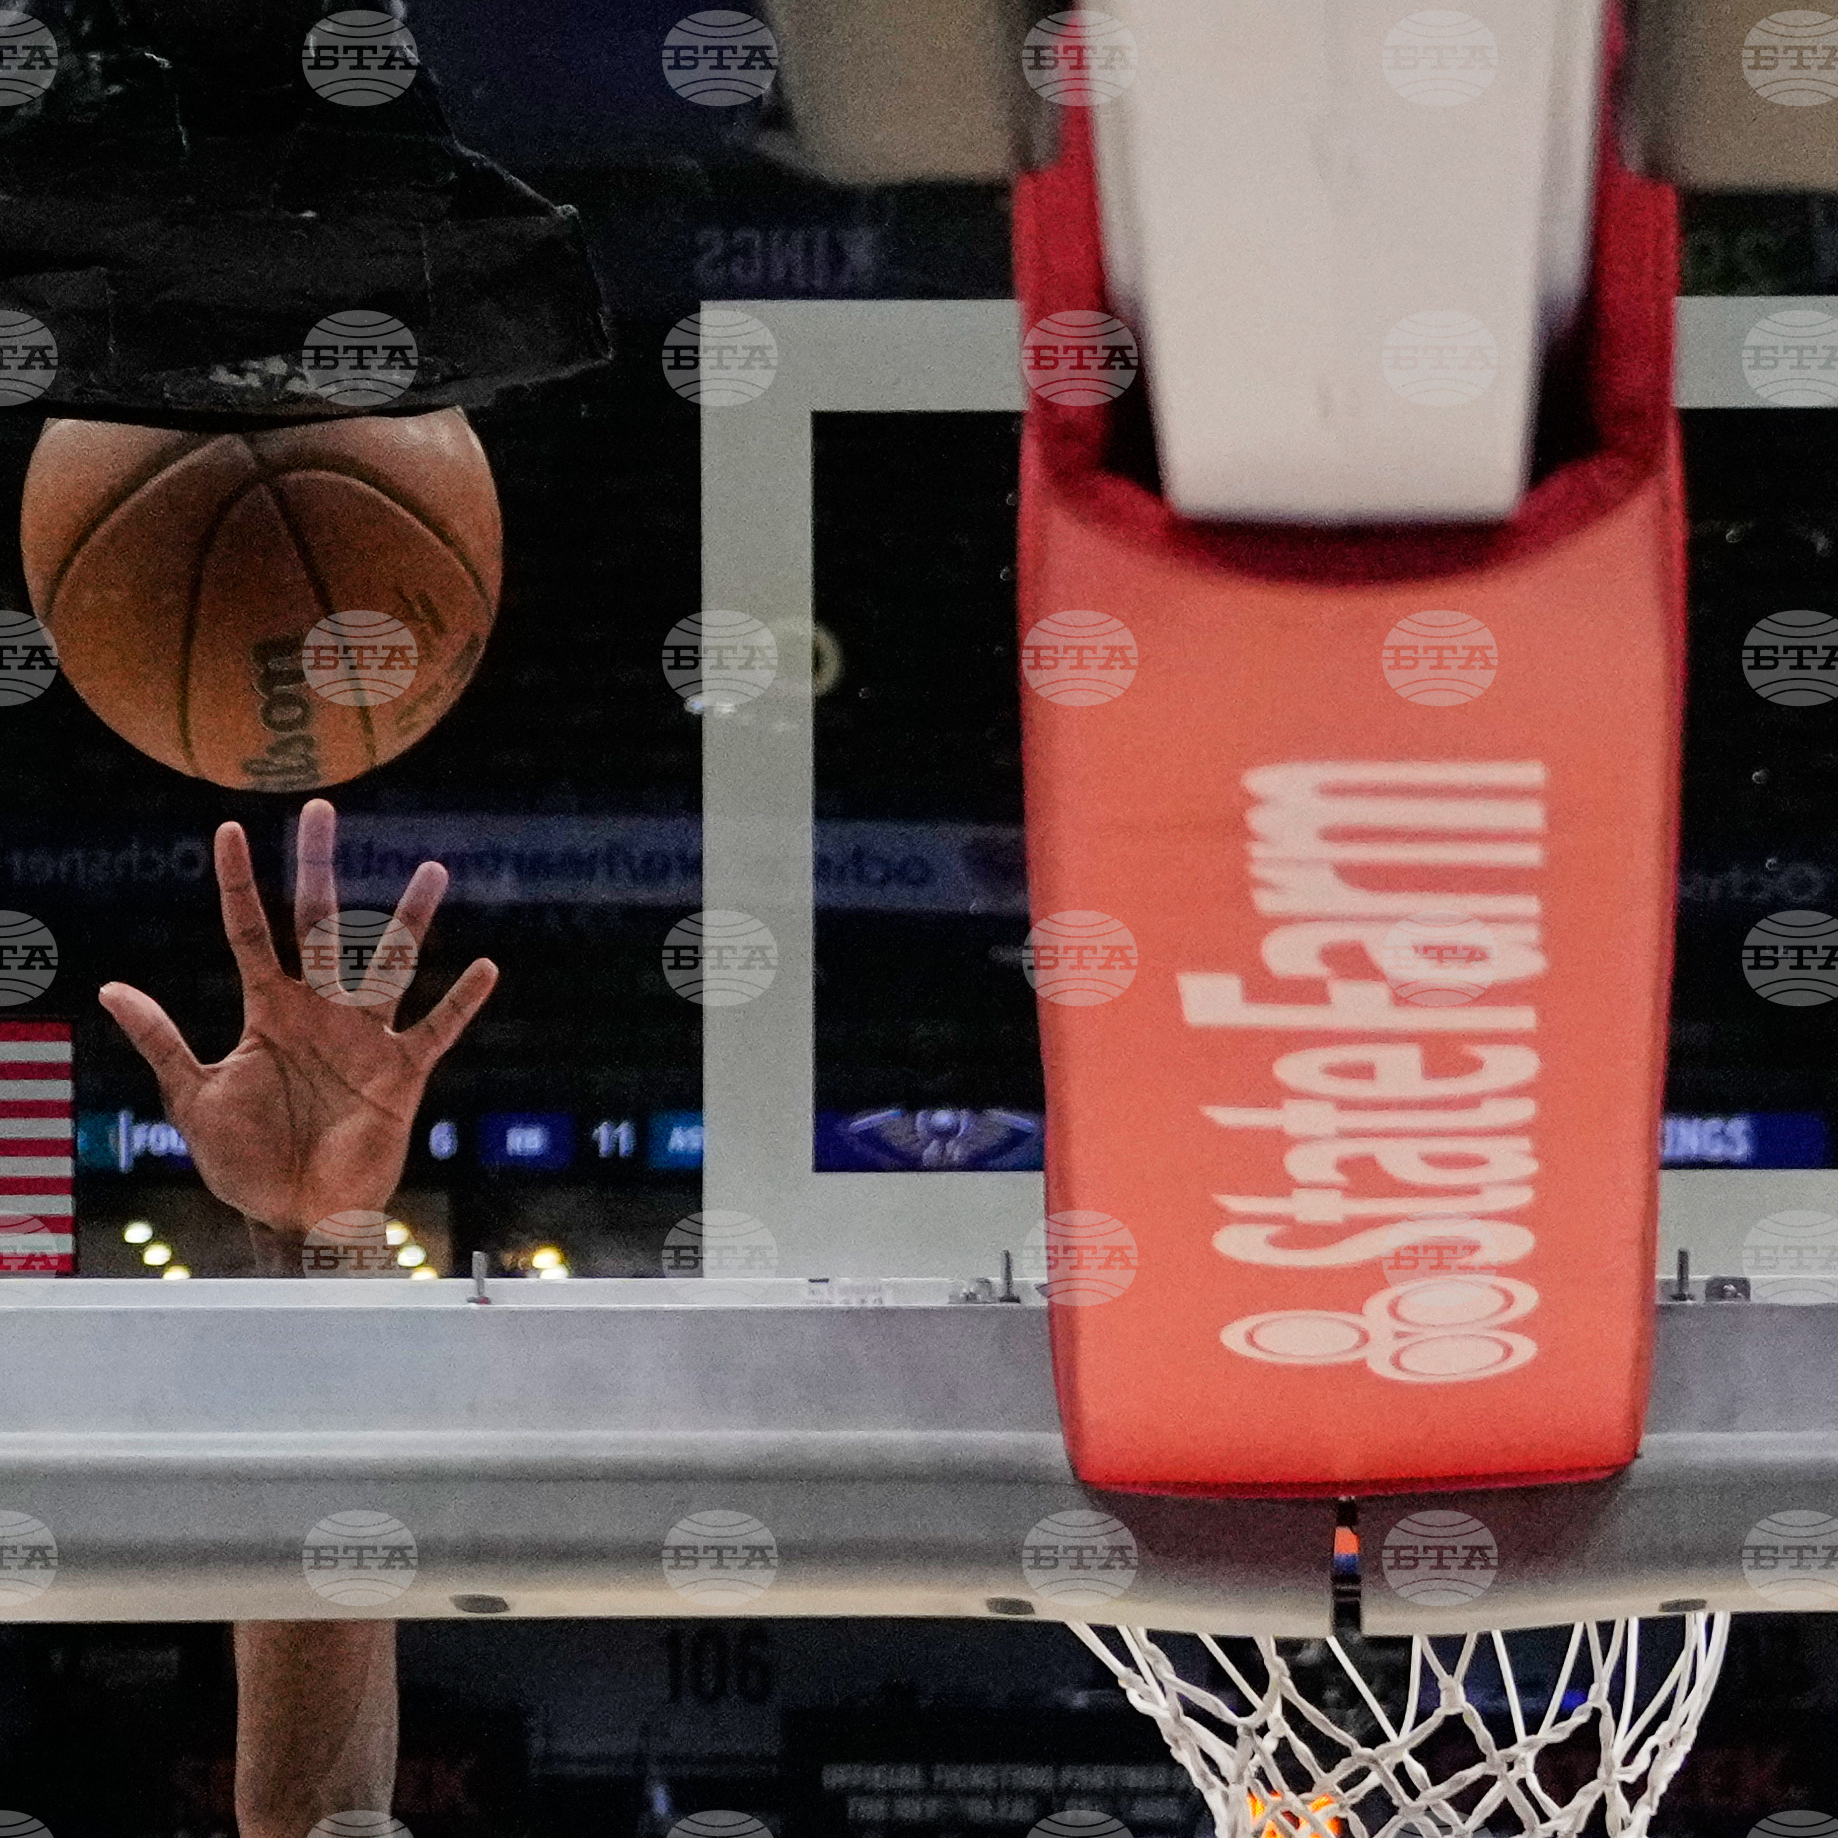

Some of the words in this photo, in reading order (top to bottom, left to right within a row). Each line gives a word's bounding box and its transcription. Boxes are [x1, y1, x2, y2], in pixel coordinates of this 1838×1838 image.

[428, 1119, 459, 1161] 6
[591, 1120, 635, 1159] 11
[1658, 1113, 1752, 1164] INGS
[666, 1627, 773, 1704] 106
